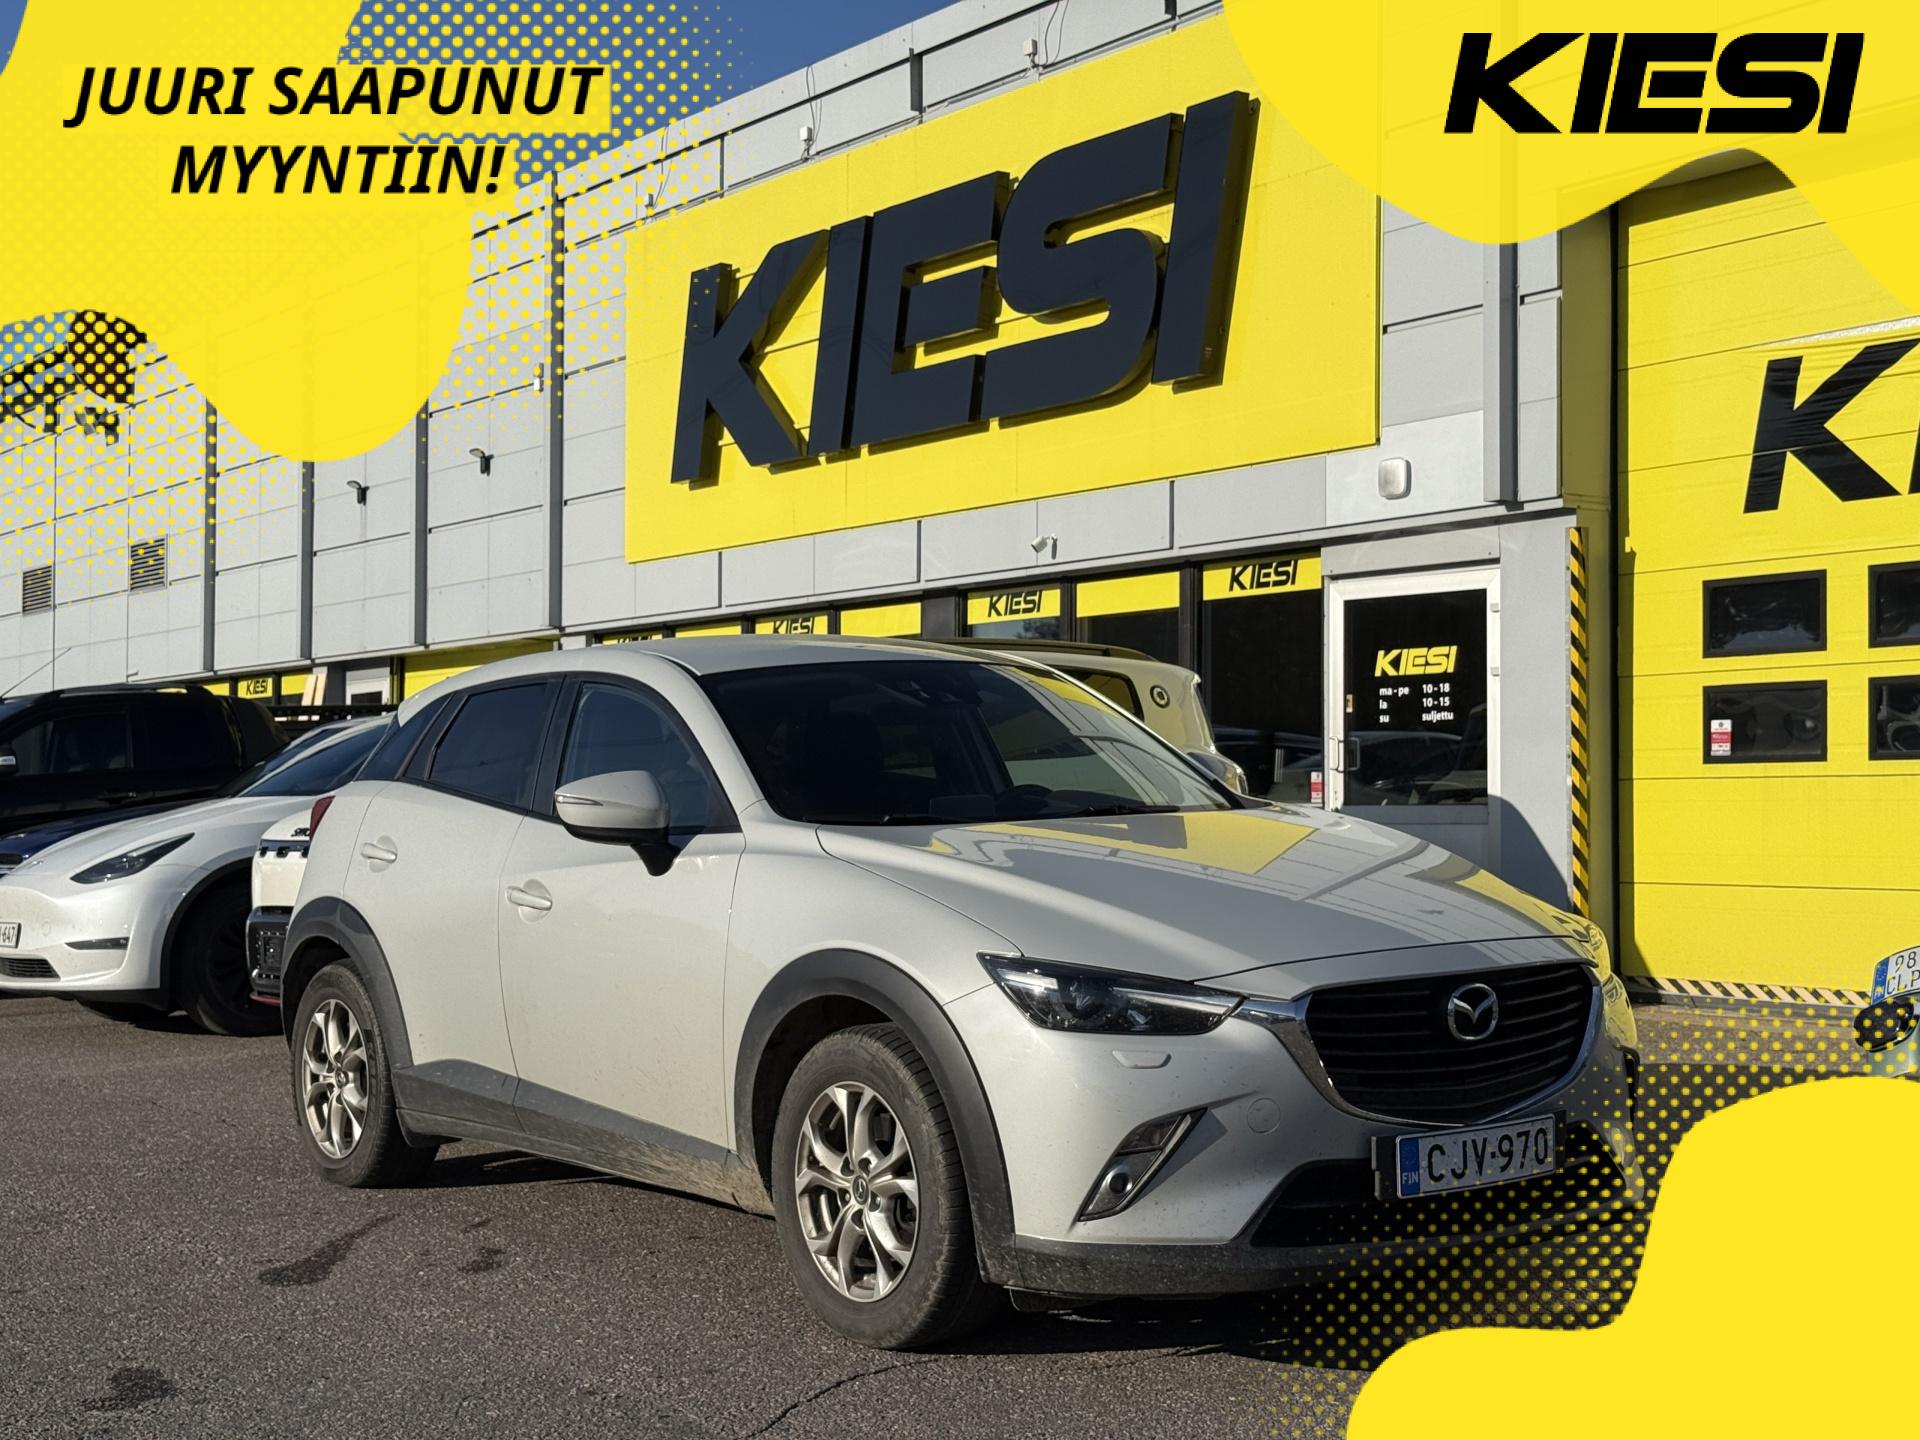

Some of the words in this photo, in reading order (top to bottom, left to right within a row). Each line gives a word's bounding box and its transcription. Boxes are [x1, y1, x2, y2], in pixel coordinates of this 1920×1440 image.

[670, 90, 1261, 488] KIESI
[1228, 559, 1300, 593] KIESI
[987, 589, 1043, 618] KIESI
[773, 616, 815, 635] KIESI
[1374, 645, 1458, 677] KIESI
[1379, 699, 1388, 710] la
[1379, 714, 1390, 723] su
[1422, 710, 1454, 723] suljettu
[1402, 1170, 1419, 1185] FIN
[1427, 1127, 1548, 1183] CJV-970
